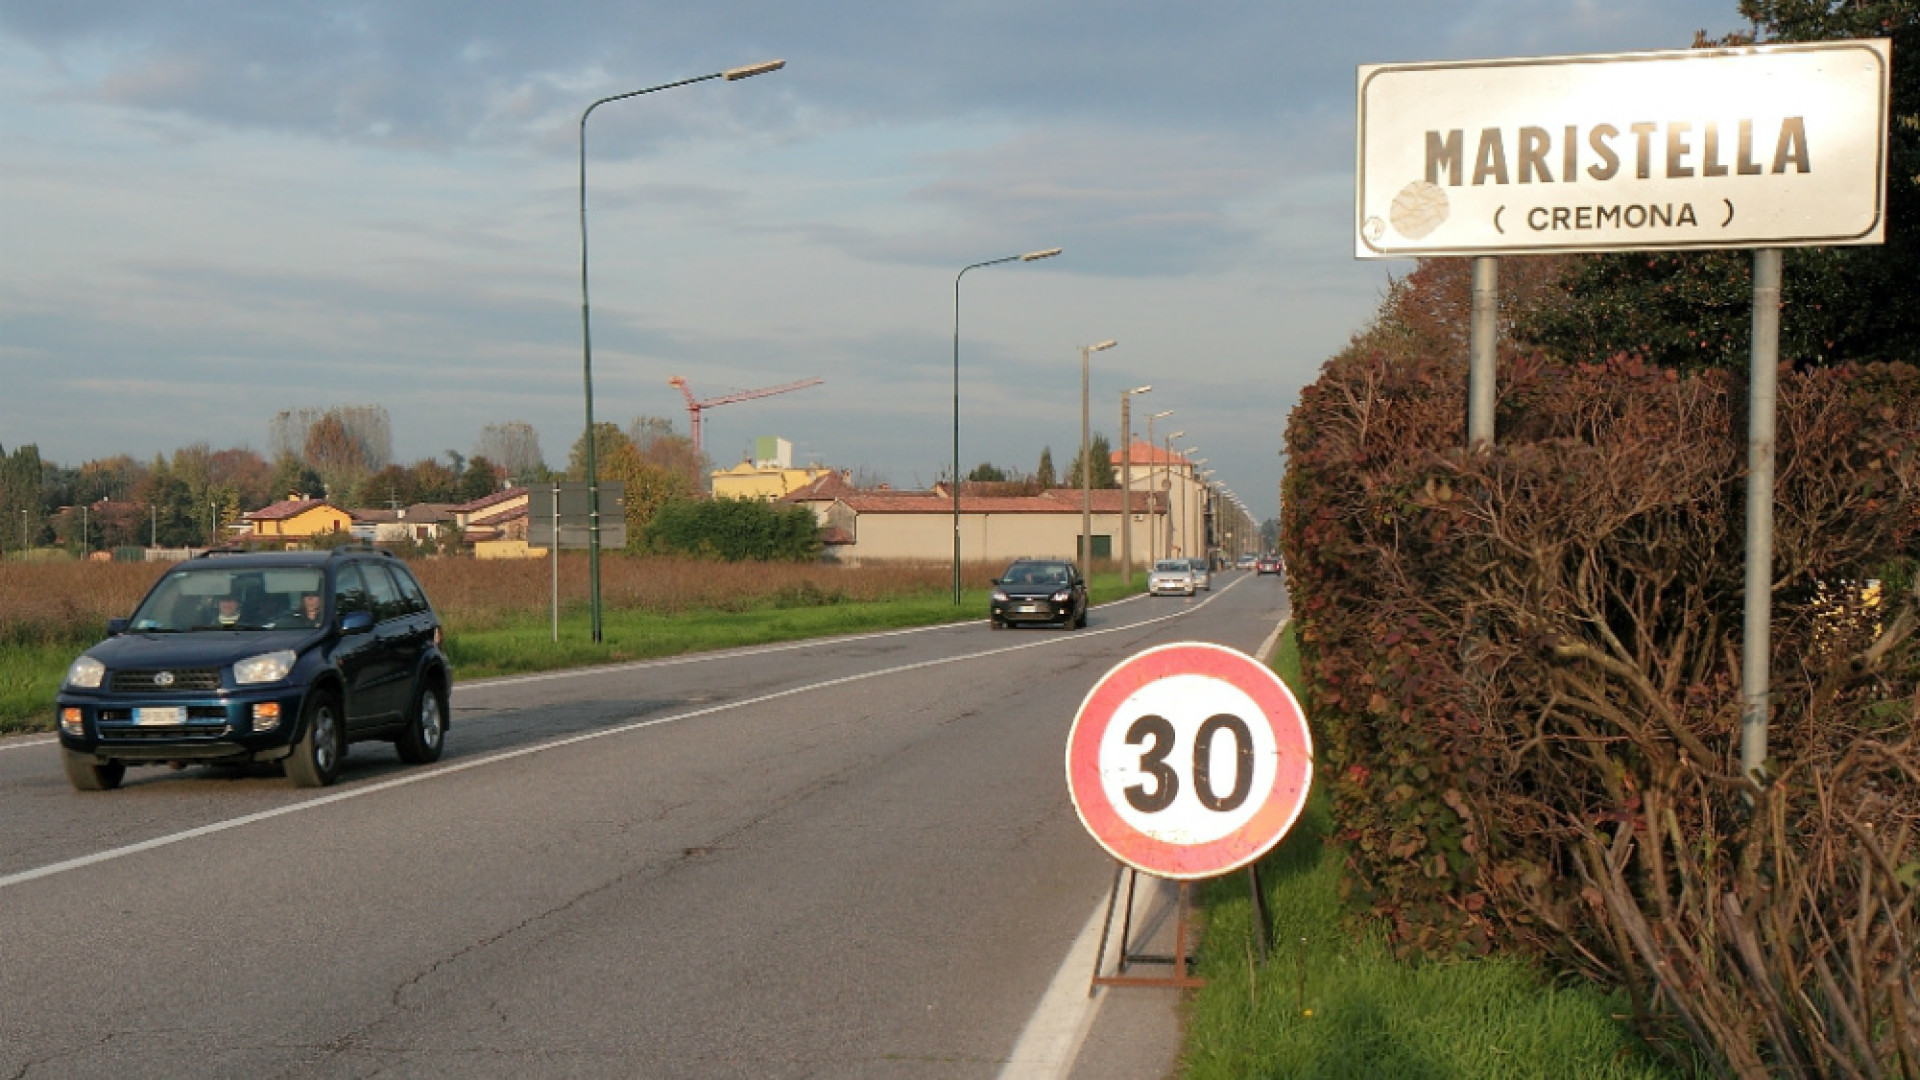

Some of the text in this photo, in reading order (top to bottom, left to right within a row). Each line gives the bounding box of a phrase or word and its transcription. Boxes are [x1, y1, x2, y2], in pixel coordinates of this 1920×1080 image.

[1425, 115, 1811, 187] MARISTELLA
[1527, 202, 1698, 231] CREMONA
[1123, 713, 1255, 814] 30
